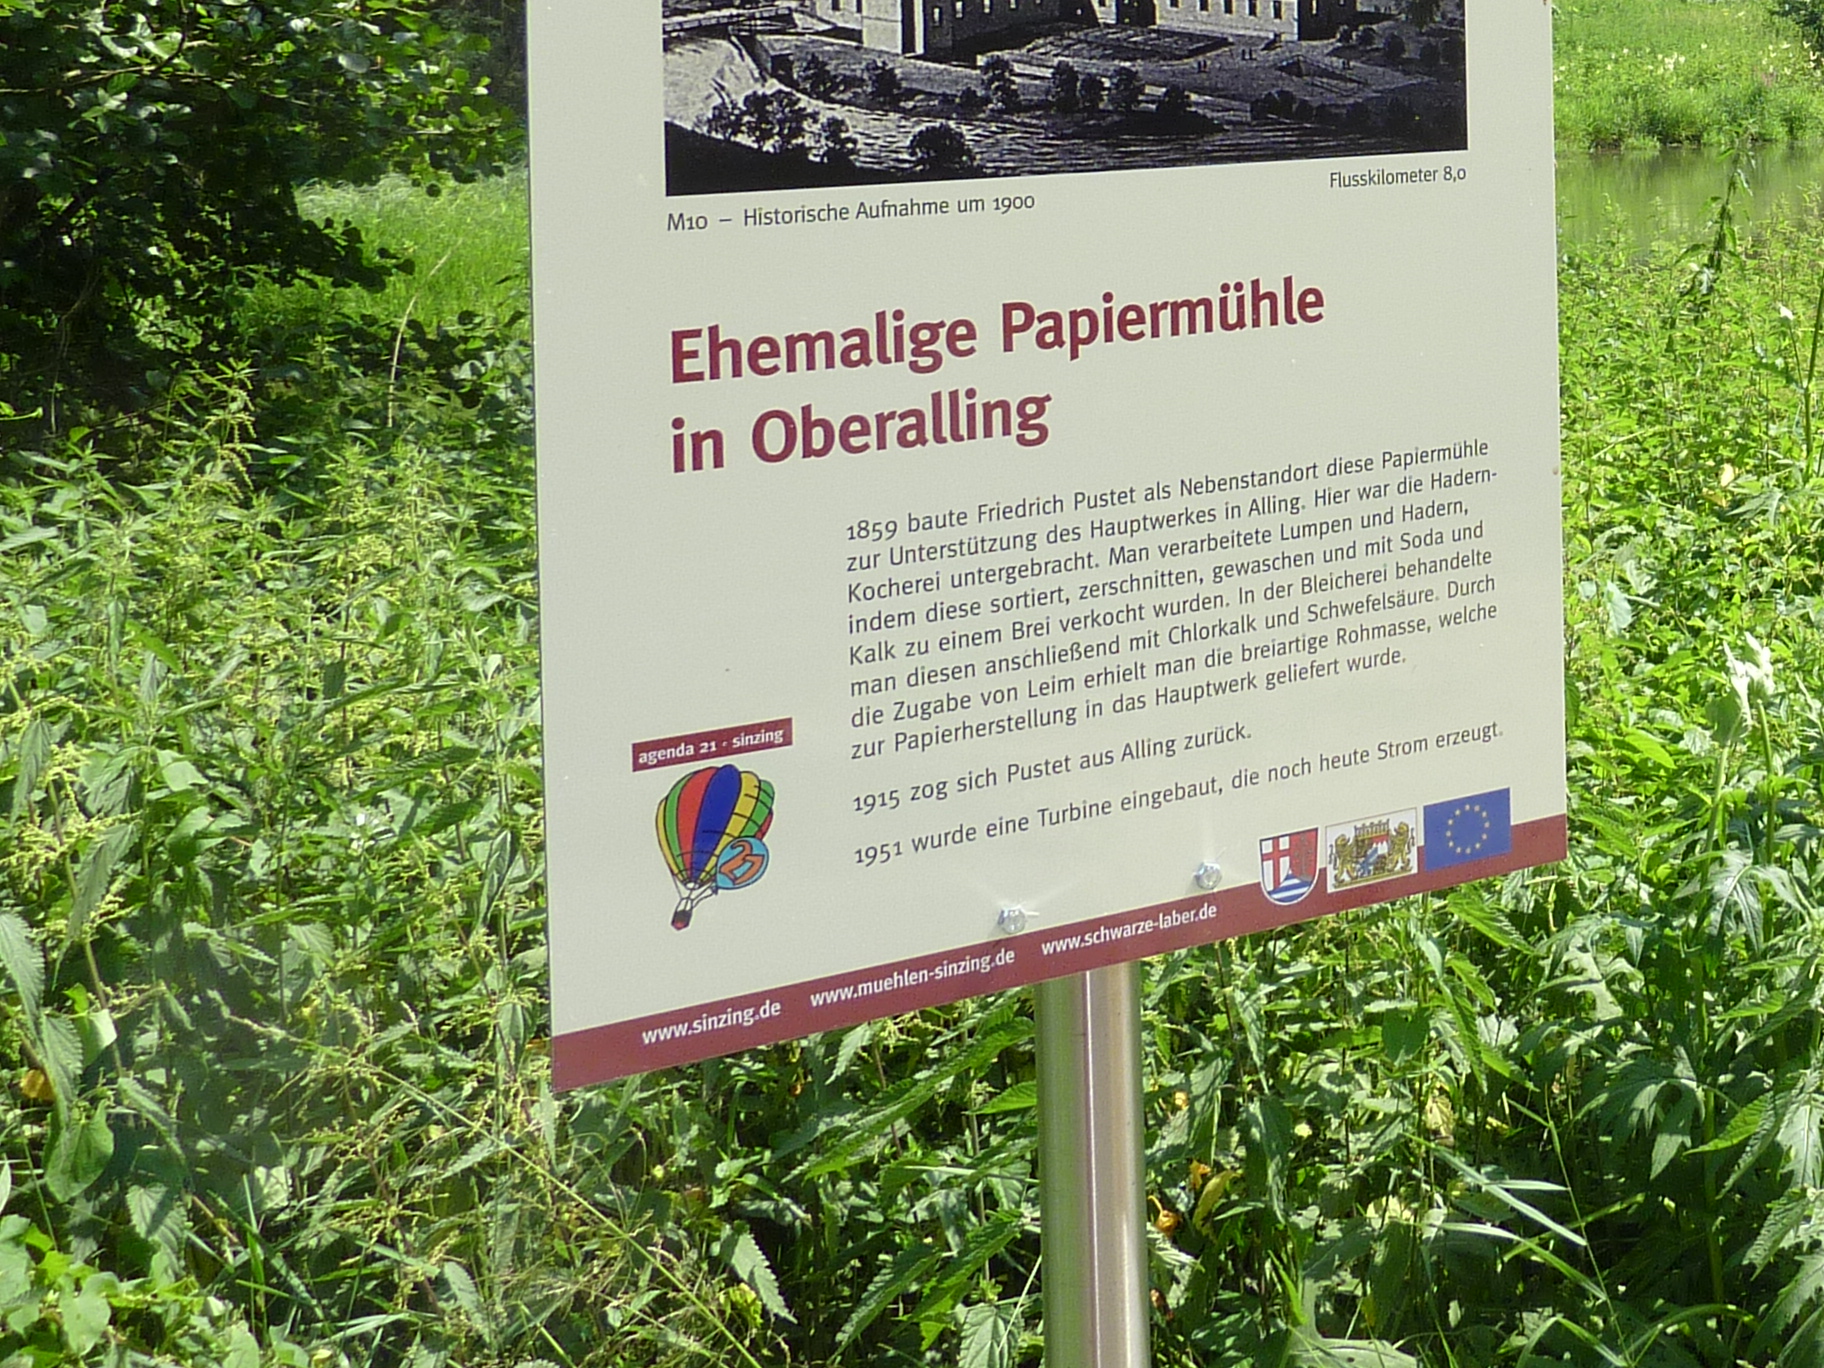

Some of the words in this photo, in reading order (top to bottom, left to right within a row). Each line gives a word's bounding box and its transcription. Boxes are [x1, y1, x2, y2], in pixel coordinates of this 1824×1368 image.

[666, 213, 709, 232] M10
[743, 203, 850, 227] Historische
[855, 198, 950, 220] Aufnahme
[956, 196, 986, 214] um
[992, 194, 1036, 215] 1900
[1329, 167, 1438, 189] Flusskilometer
[1443, 165, 1467, 183] 8,0
[670, 309, 977, 385] Ehemalige
[1000, 275, 1325, 362] Papiermühle
[671, 416, 725, 474] in
[751, 386, 1052, 466] Oberalling
[847, 520, 897, 542] 1859
[908, 510, 967, 532] baute
[978, 494, 1063, 523] Friedrich
[1074, 487, 1136, 511] Pustet
[1145, 481, 1171, 501] als
[1181, 462, 1318, 497] Nebenstandort
[1327, 457, 1373, 476] diese
[1383, 439, 1488, 471] Papiermühle
[847, 553, 881, 572] zur
[890, 533, 1037, 565] Unterstützung
[1046, 524, 1081, 544] des
[1091, 507, 1216, 539] Hauptwerkes
[1225, 502, 1241, 520] in
[1248, 495, 1305, 517] Alling.
[1315, 487, 1350, 507] Hier
[1357, 484, 1390, 501] war
[1397, 476, 1423, 494] die
[1431, 468, 1497, 490] Hadern-
[849, 571, 940, 603] Kocherei
[951, 551, 1099, 588] untergebracht.
[1109, 546, 1149, 566] Man
[1158, 528, 1271, 558] verarbeitete
[1281, 518, 1352, 541] Lumpen
[1361, 506, 1393, 529] und
[1402, 500, 1468, 522] Hadern,
[849, 610, 915, 634] indem
[926, 601, 981, 622] diese
[991, 586, 1070, 613] sortiert,
[1079, 569, 1203, 600] zerschnitten,
[1213, 551, 1314, 584] gewaschen
[1323, 540, 1356, 563] und
[1365, 536, 1393, 556] mit
[1400, 528, 1444, 550] Soda
[1452, 520, 1483, 542] und
[850, 640, 896, 665] Kalk
[905, 640, 929, 657] zu
[939, 629, 1001, 651] einem
[1012, 616, 1050, 640] Brei
[1059, 604, 1145, 632] verkocht
[1153, 593, 1230, 618] wurden.
[1239, 587, 1254, 605] In
[1264, 581, 1293, 600] der
[1302, 564, 1387, 595] Bleicherei
[1396, 549, 1491, 579] behandelte
[851, 676, 896, 697] man
[907, 664, 975, 687] diesen
[986, 635, 1119, 675] anschließend
[1130, 630, 1160, 651] mit
[1169, 614, 1257, 644] Chlorkalk
[1265, 606, 1299, 629] und
[1308, 589, 1439, 622] Schwefelsäure.
[1448, 574, 1494, 598] Durch
[851, 740, 885, 759] zur
[895, 707, 1077, 752] Papierherstellung
[1086, 699, 1102, 718] in
[1113, 693, 1146, 713] das
[1156, 671, 1257, 706] Hauptwerk
[1266, 659, 1339, 690] geliefert
[1347, 647, 1405, 672] wurde.
[852, 706, 884, 727] die
[893, 692, 971, 721] Zugabe
[980, 687, 1017, 706] von
[1028, 675, 1074, 698] Leim
[1084, 661, 1146, 688] erhielt
[1156, 657, 1195, 677] man
[1205, 648, 1232, 668] die
[1242, 634, 1328, 662] breiartige
[1337, 619, 1431, 645] Rohmasse,
[1439, 603, 1497, 628] welche
[638, 743, 695, 766] agenda
[699, 740, 717, 754] 21
[732, 728, 784, 749] sinzing
[853, 790, 899, 815] 1915
[910, 781, 948, 801] zog
[957, 768, 997, 792] sich
[1008, 755, 1071, 783] Pustet
[1080, 750, 1114, 769] aus
[1121, 738, 1176, 762] Alling
[1184, 722, 1251, 750] zurück.
[855, 841, 902, 867] 1951
[912, 824, 976, 853] wurde
[986, 816, 1029, 837] eine
[1037, 800, 1111, 827] Turbine
[1121, 777, 1222, 811] eingebaut,
[1232, 768, 1259, 789] die
[1269, 757, 1311, 782] noch
[1320, 749, 1369, 772] heute
[1378, 738, 1428, 760] Strom
[1436, 722, 1502, 748] erzeugt.
[641, 999, 782, 1046] www.sinzing.de
[810, 947, 1015, 1009] www.muehlen-sinzing.de
[1040, 902, 1218, 957] www.schwarze-laber.de
